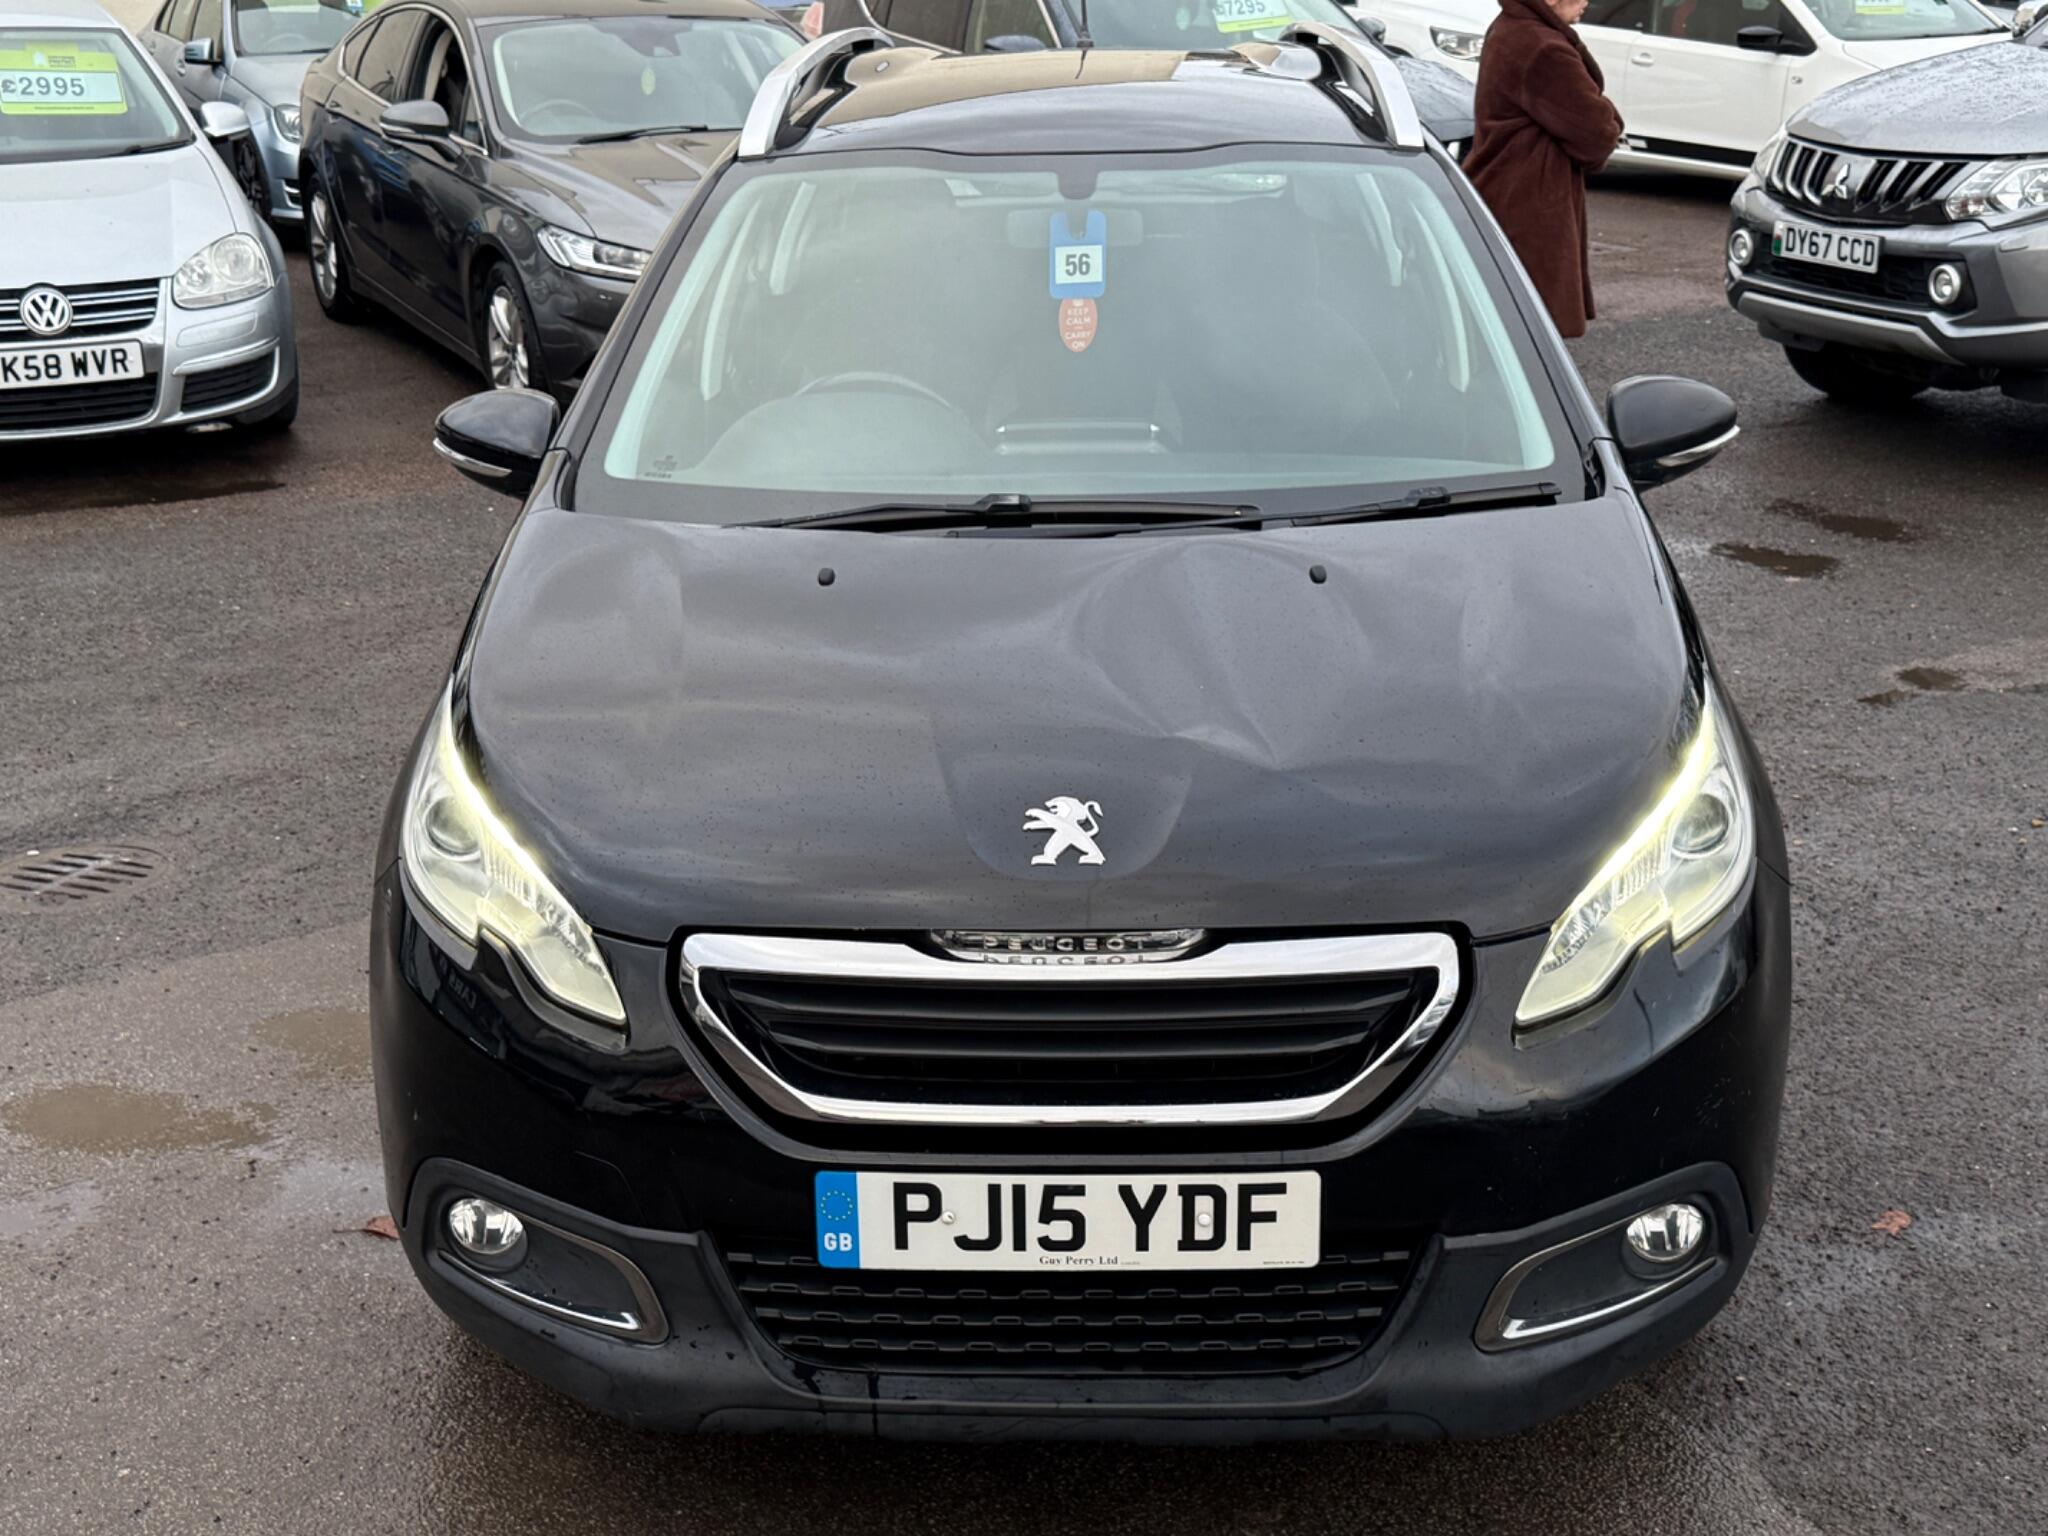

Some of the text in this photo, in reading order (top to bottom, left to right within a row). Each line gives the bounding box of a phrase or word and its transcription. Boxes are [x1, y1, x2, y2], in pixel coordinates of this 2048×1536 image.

[1, 76, 85, 97] £2995
[1785, 227, 1875, 266] DY67 CCD
[1065, 253, 1091, 276] 56
[0, 348, 129, 382] K58 WVR
[893, 1182, 1288, 1252] PJ15 YDF
[823, 1232, 853, 1252] GB
[1039, 1256, 1061, 1266] Guy
[1065, 1256, 1095, 1266] Perry
[1099, 1255, 1118, 1265] Ltd
